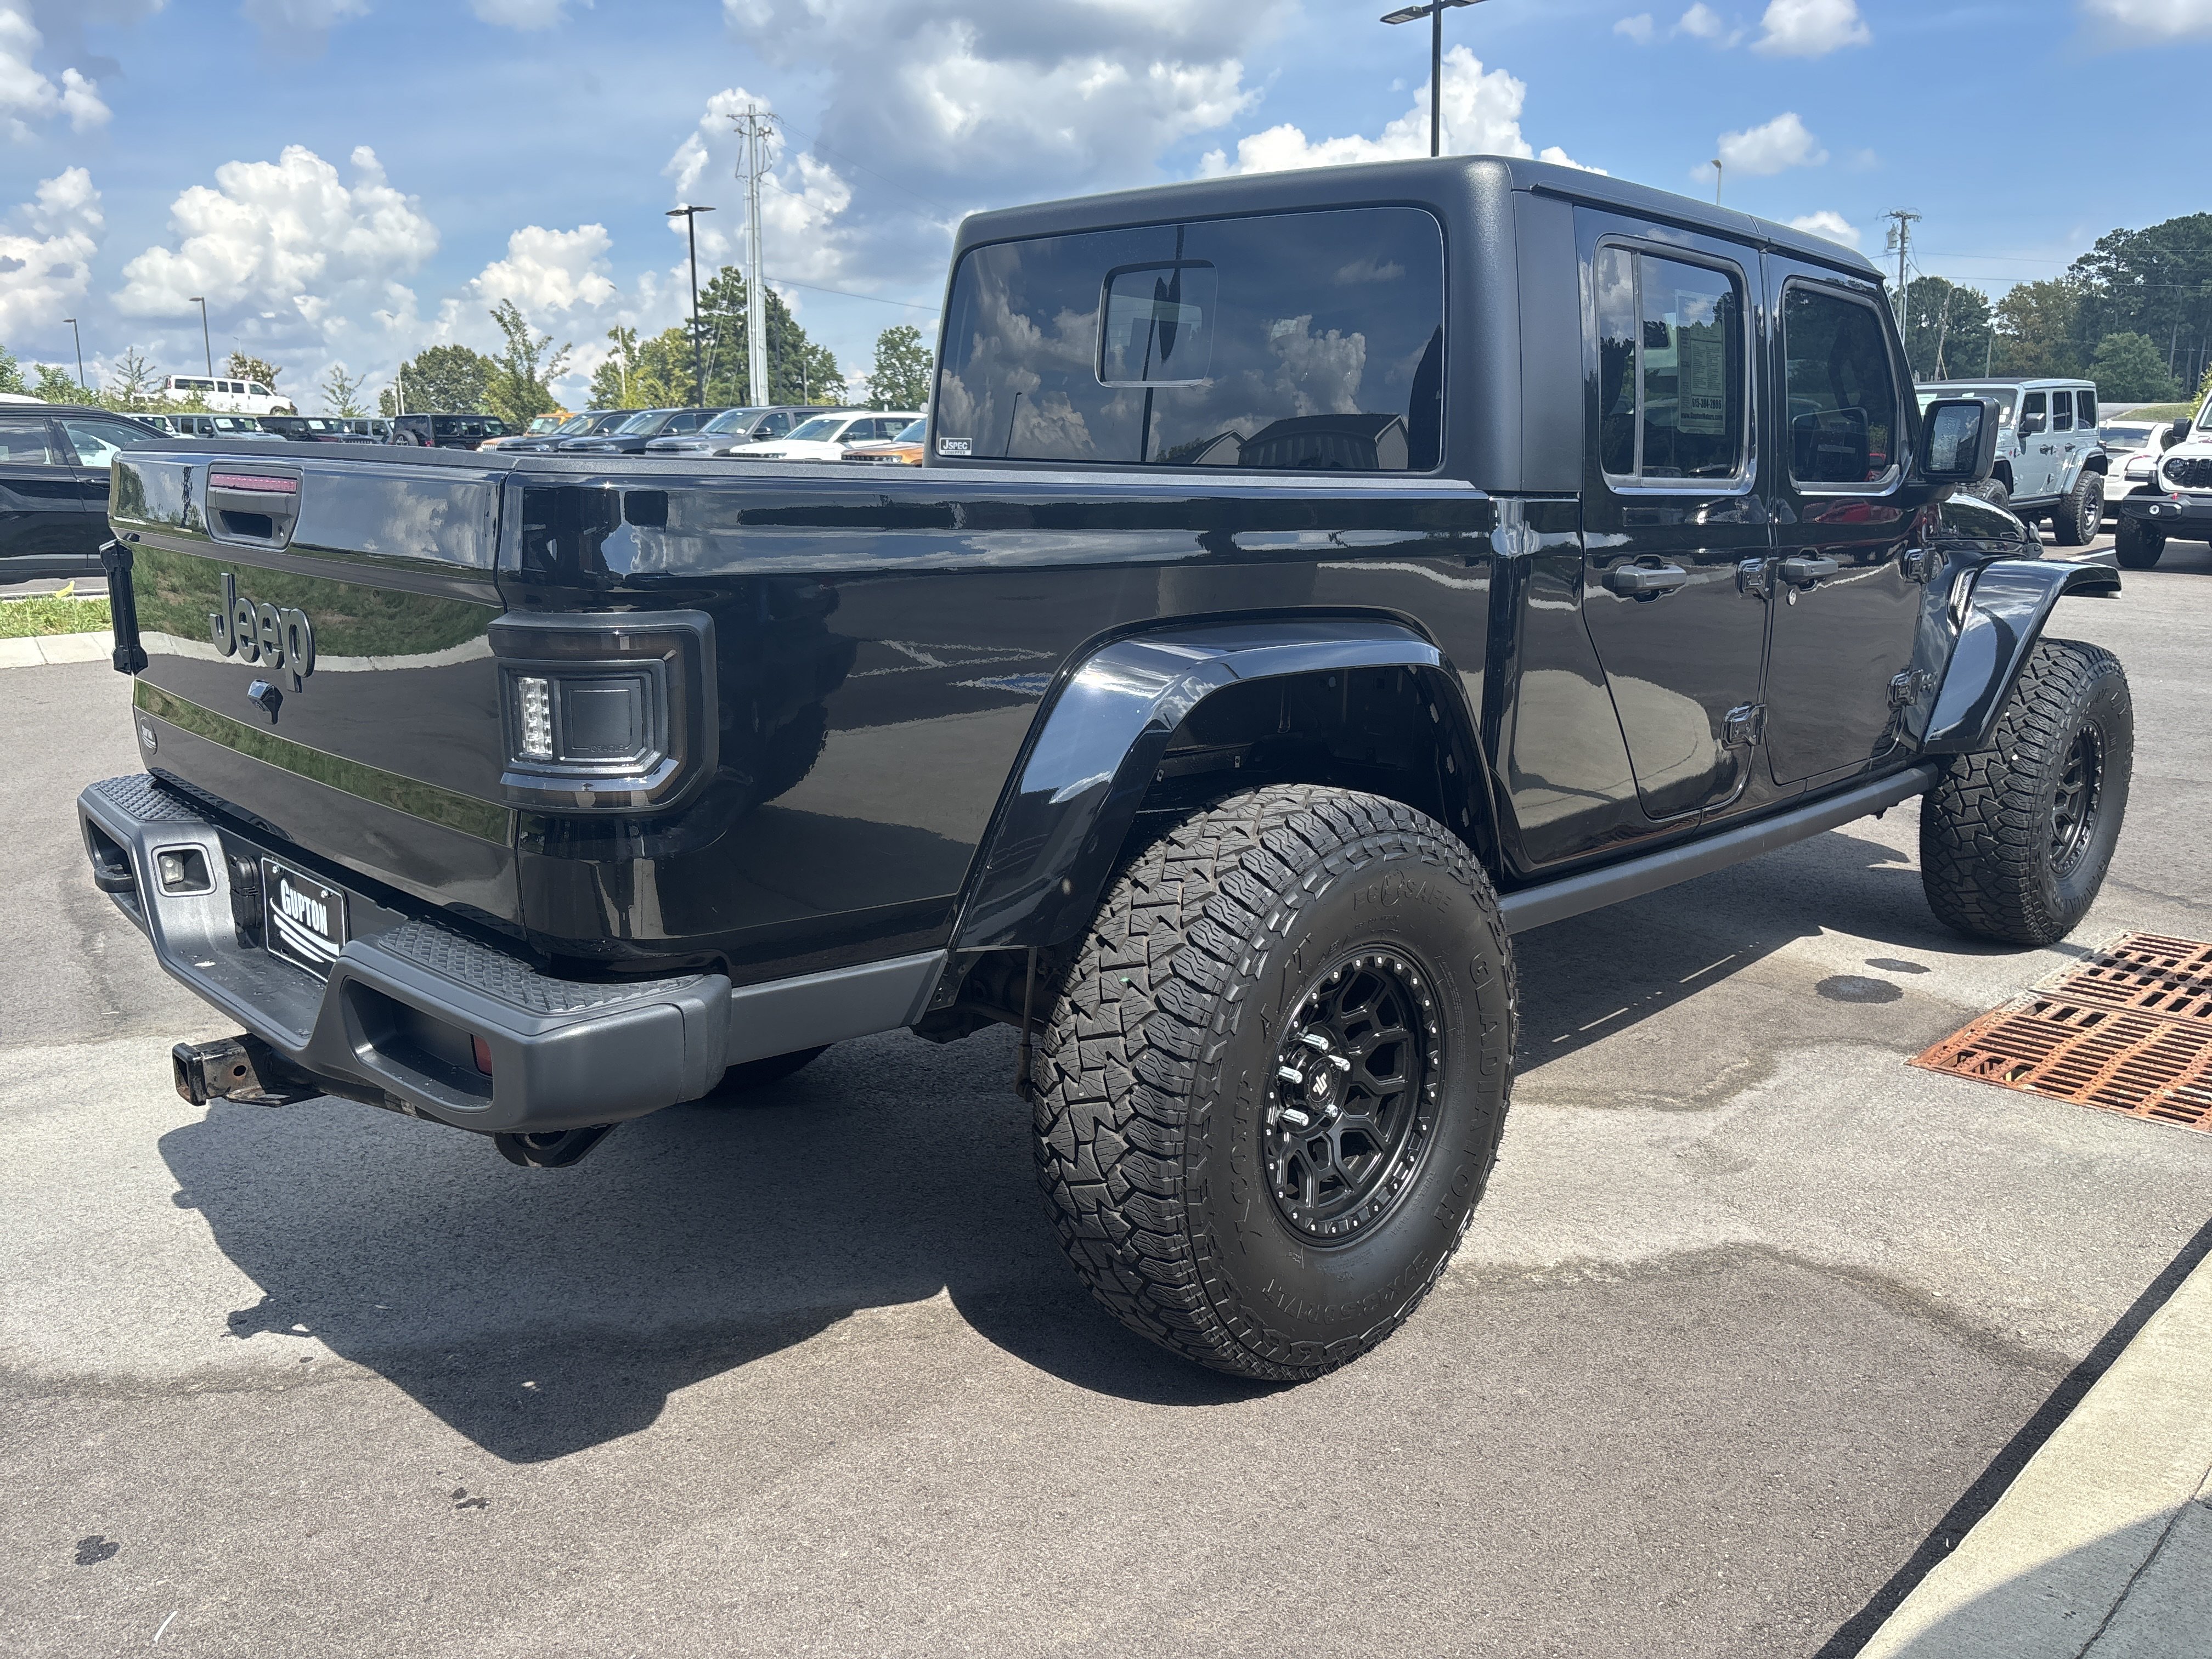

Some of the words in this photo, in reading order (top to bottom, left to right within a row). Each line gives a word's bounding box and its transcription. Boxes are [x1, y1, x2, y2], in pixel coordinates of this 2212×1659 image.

[943, 439, 968, 449] JSPEC
[209, 572, 315, 693] Jeep
[280, 878, 328, 936] GUPTON
[1434, 951, 1498, 1229] GLADIATOR
